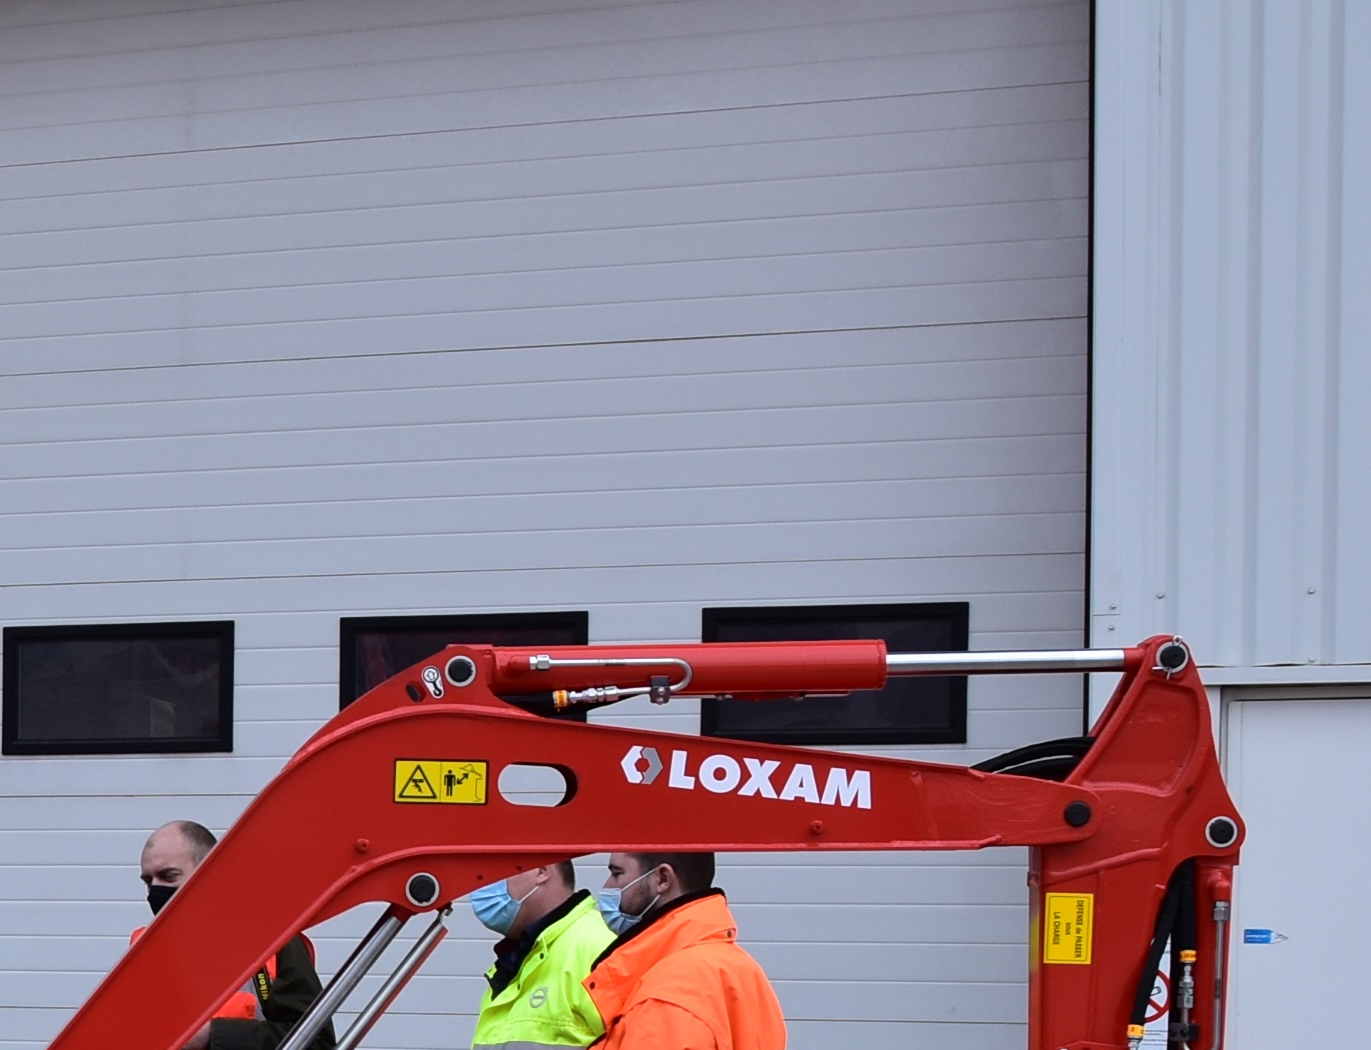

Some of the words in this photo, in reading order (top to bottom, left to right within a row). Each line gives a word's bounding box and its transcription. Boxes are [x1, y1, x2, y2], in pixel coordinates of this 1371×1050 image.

[668, 749, 872, 810] LOXAM
[1076, 900, 1084, 925] DEFENSE
[257, 973, 269, 1000] Nikon
